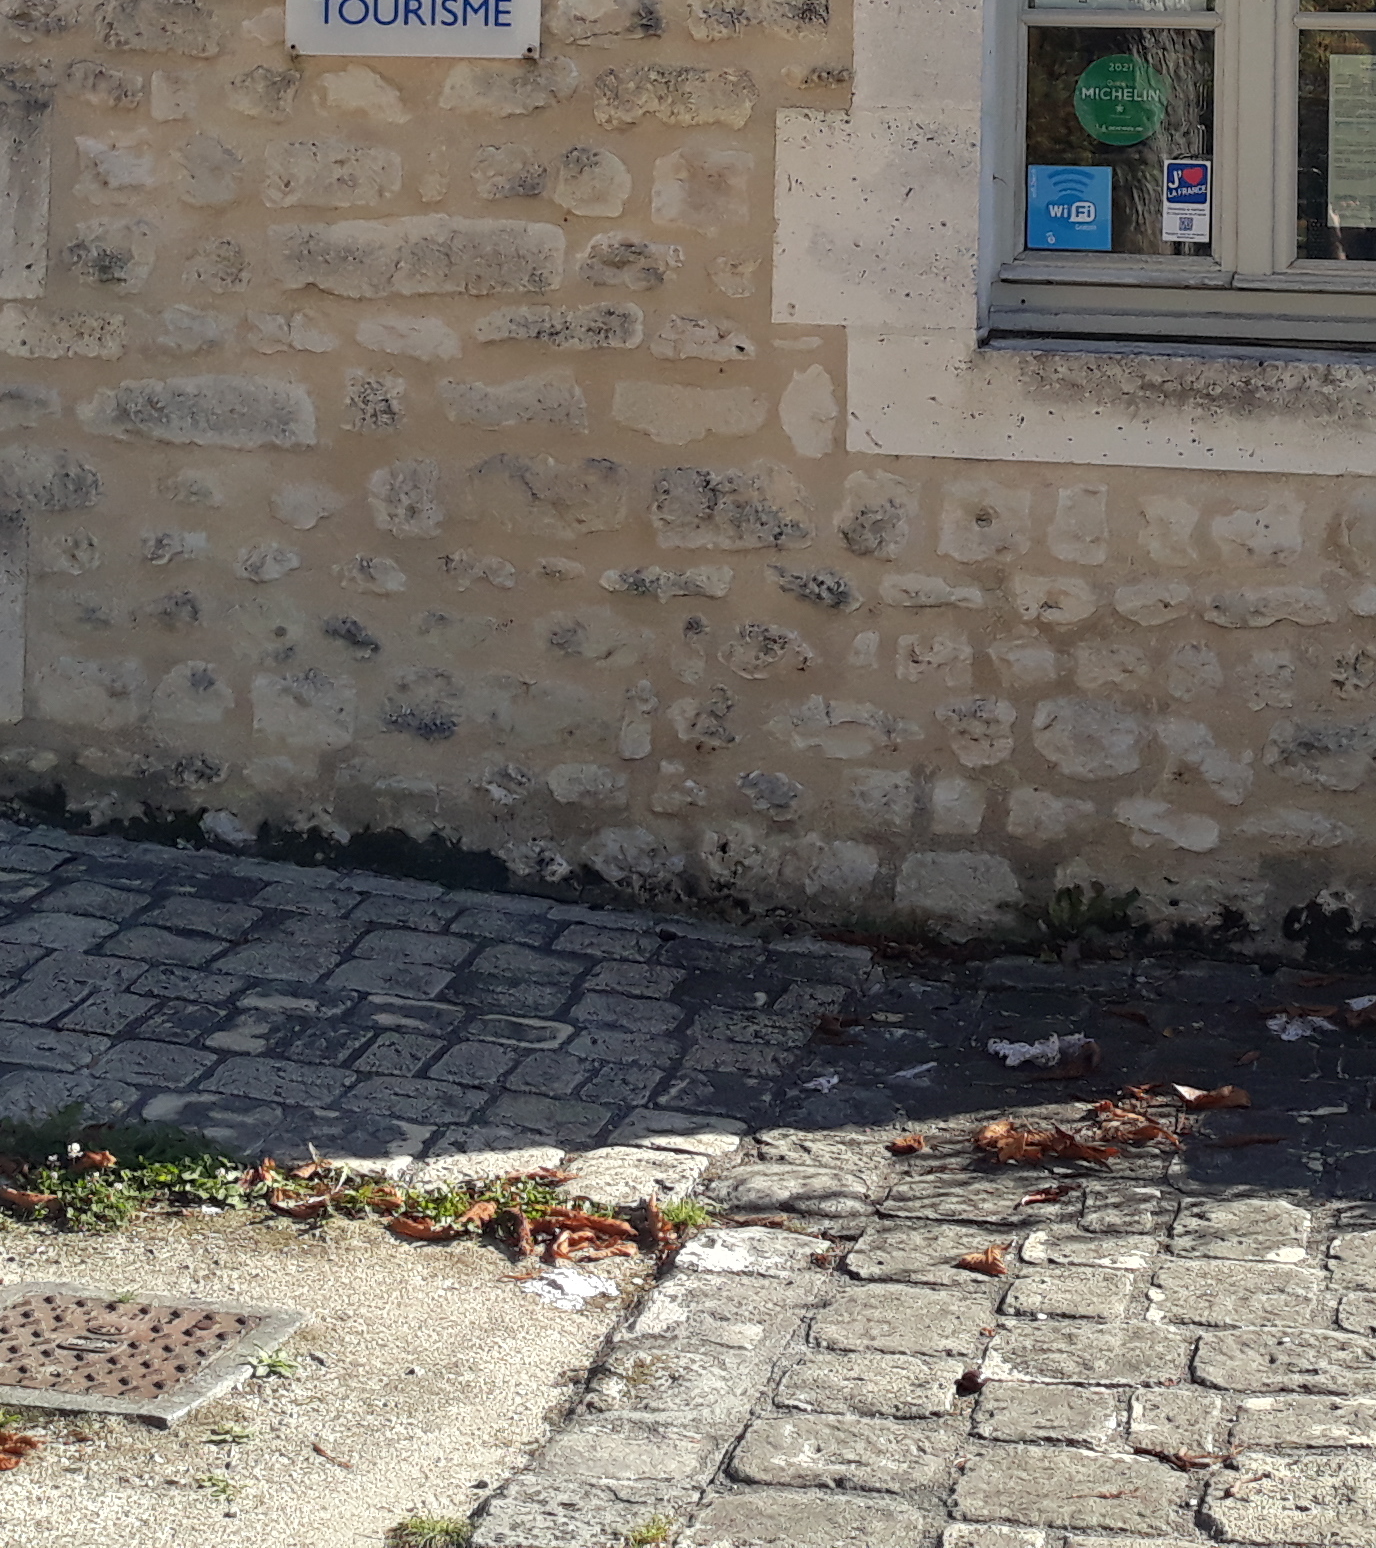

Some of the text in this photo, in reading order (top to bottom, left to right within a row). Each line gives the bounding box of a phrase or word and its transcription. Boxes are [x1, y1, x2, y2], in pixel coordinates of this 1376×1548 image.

[1108, 63, 1133, 72] 2021
[1081, 87, 1160, 102] MICHELIN
[1167, 185, 1207, 198] LA FRANCE
